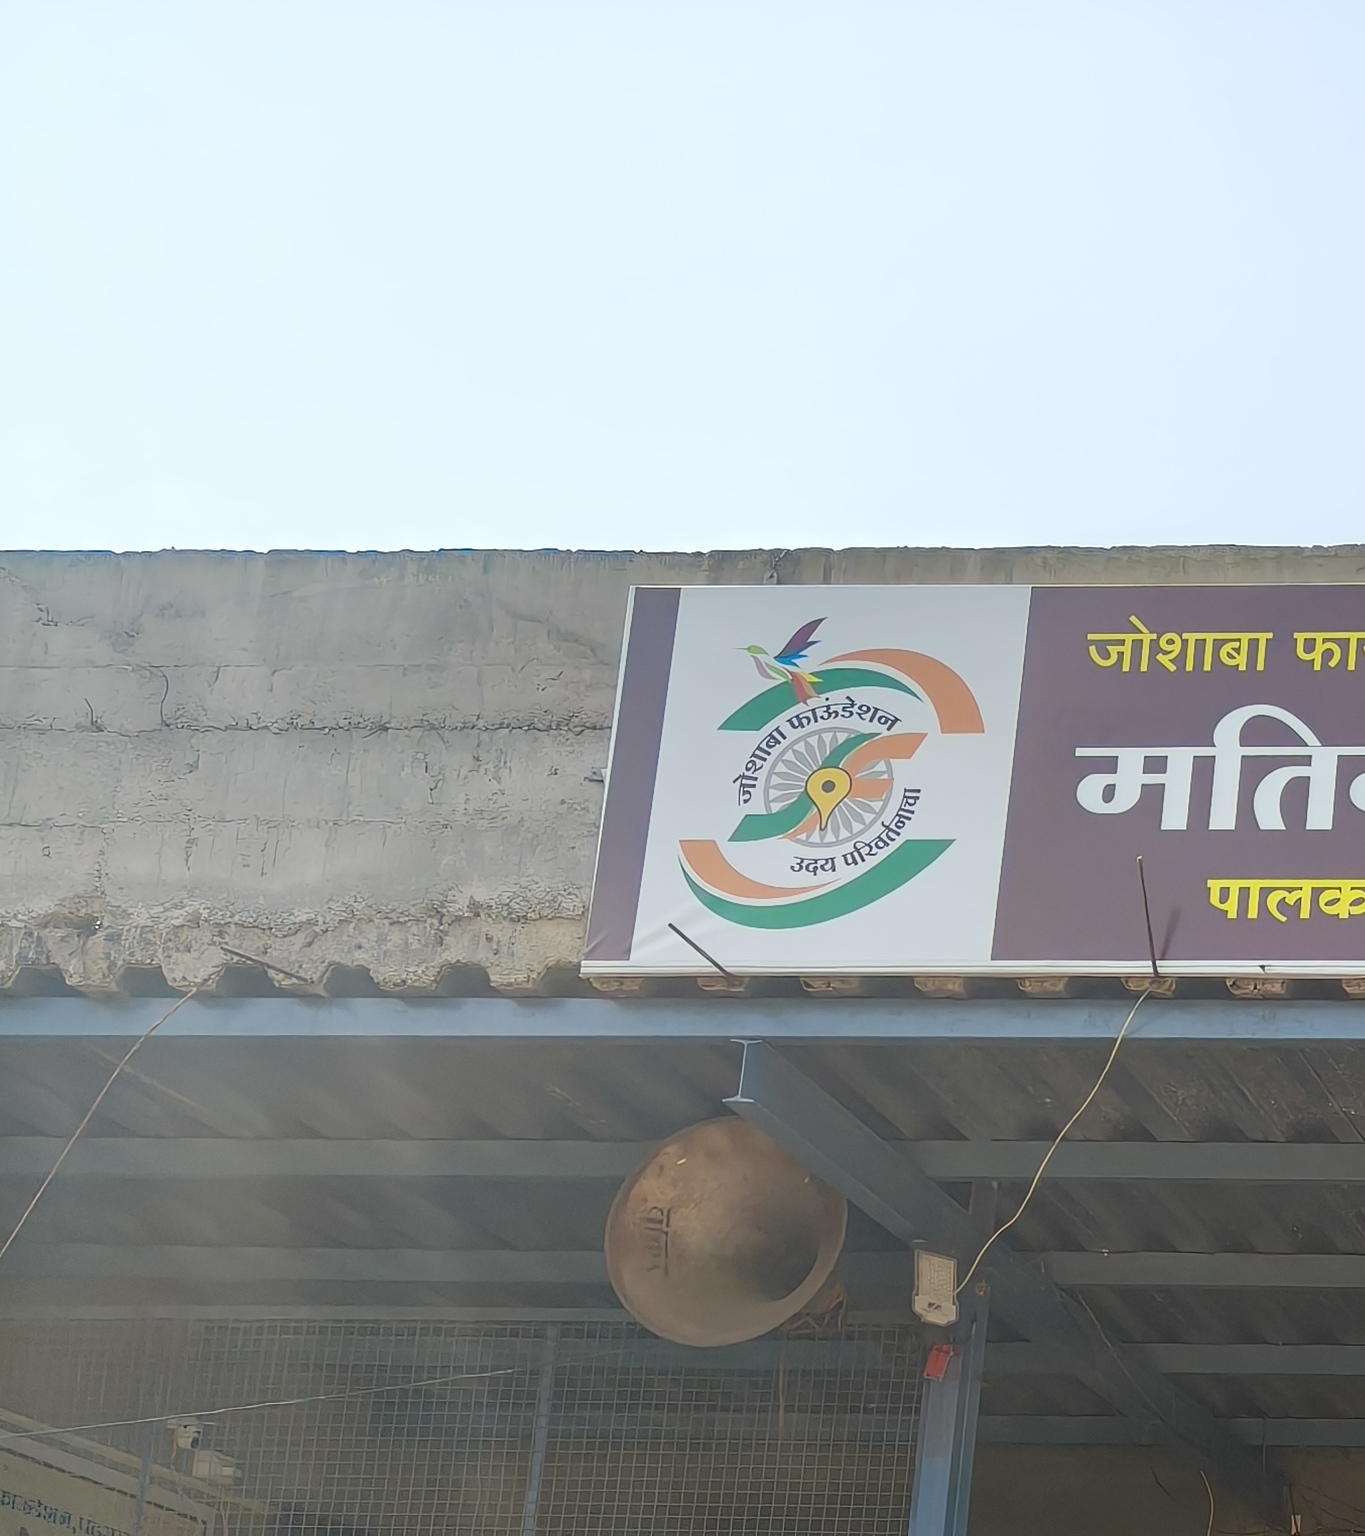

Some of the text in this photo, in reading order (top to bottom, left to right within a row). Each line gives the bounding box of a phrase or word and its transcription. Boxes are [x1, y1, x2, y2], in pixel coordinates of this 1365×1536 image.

[1086, 614, 1274, 674] जोशाबा
[733, 696, 903, 806] जोशाबा फाऊंडेशन
[790, 787, 922, 877] उदय परिवर्तनाचा
